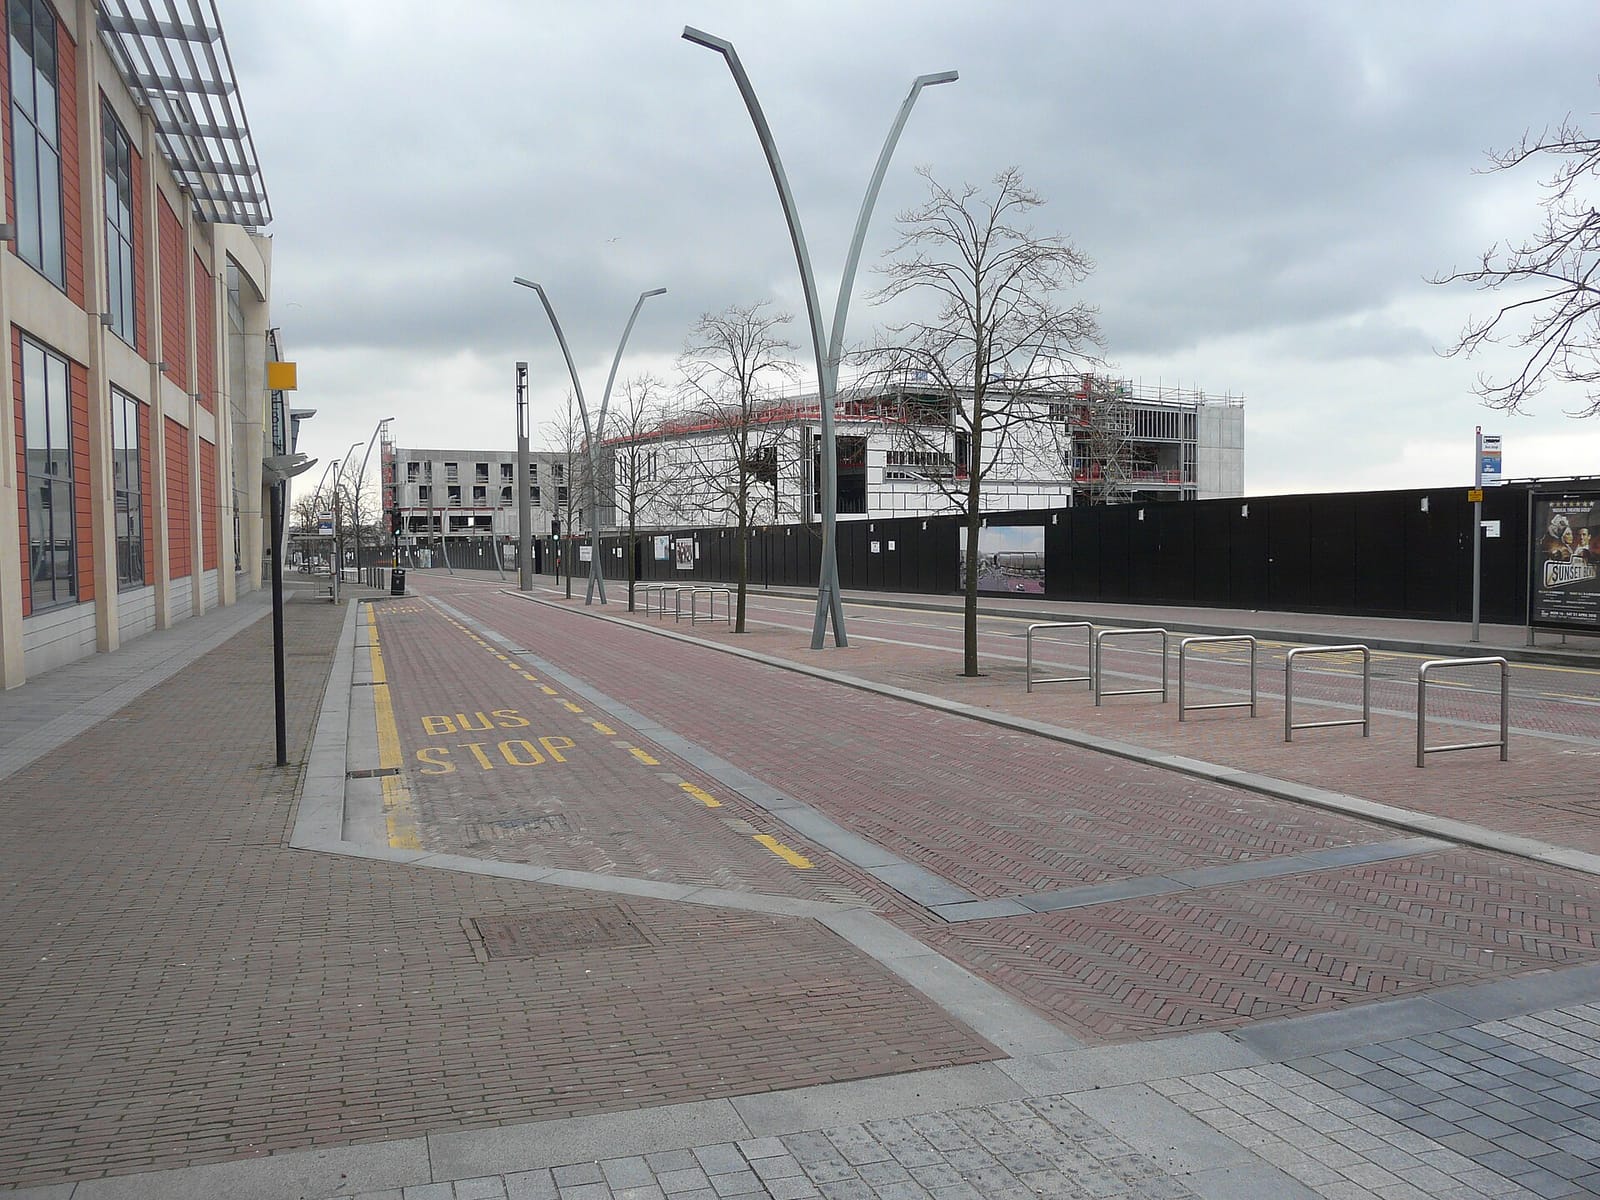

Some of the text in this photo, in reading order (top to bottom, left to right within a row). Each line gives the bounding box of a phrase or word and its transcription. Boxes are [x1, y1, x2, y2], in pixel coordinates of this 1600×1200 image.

[1552, 565, 1581, 582] SUNSET
[421, 709, 530, 736] BUS
[416, 736, 576, 775] STOP
